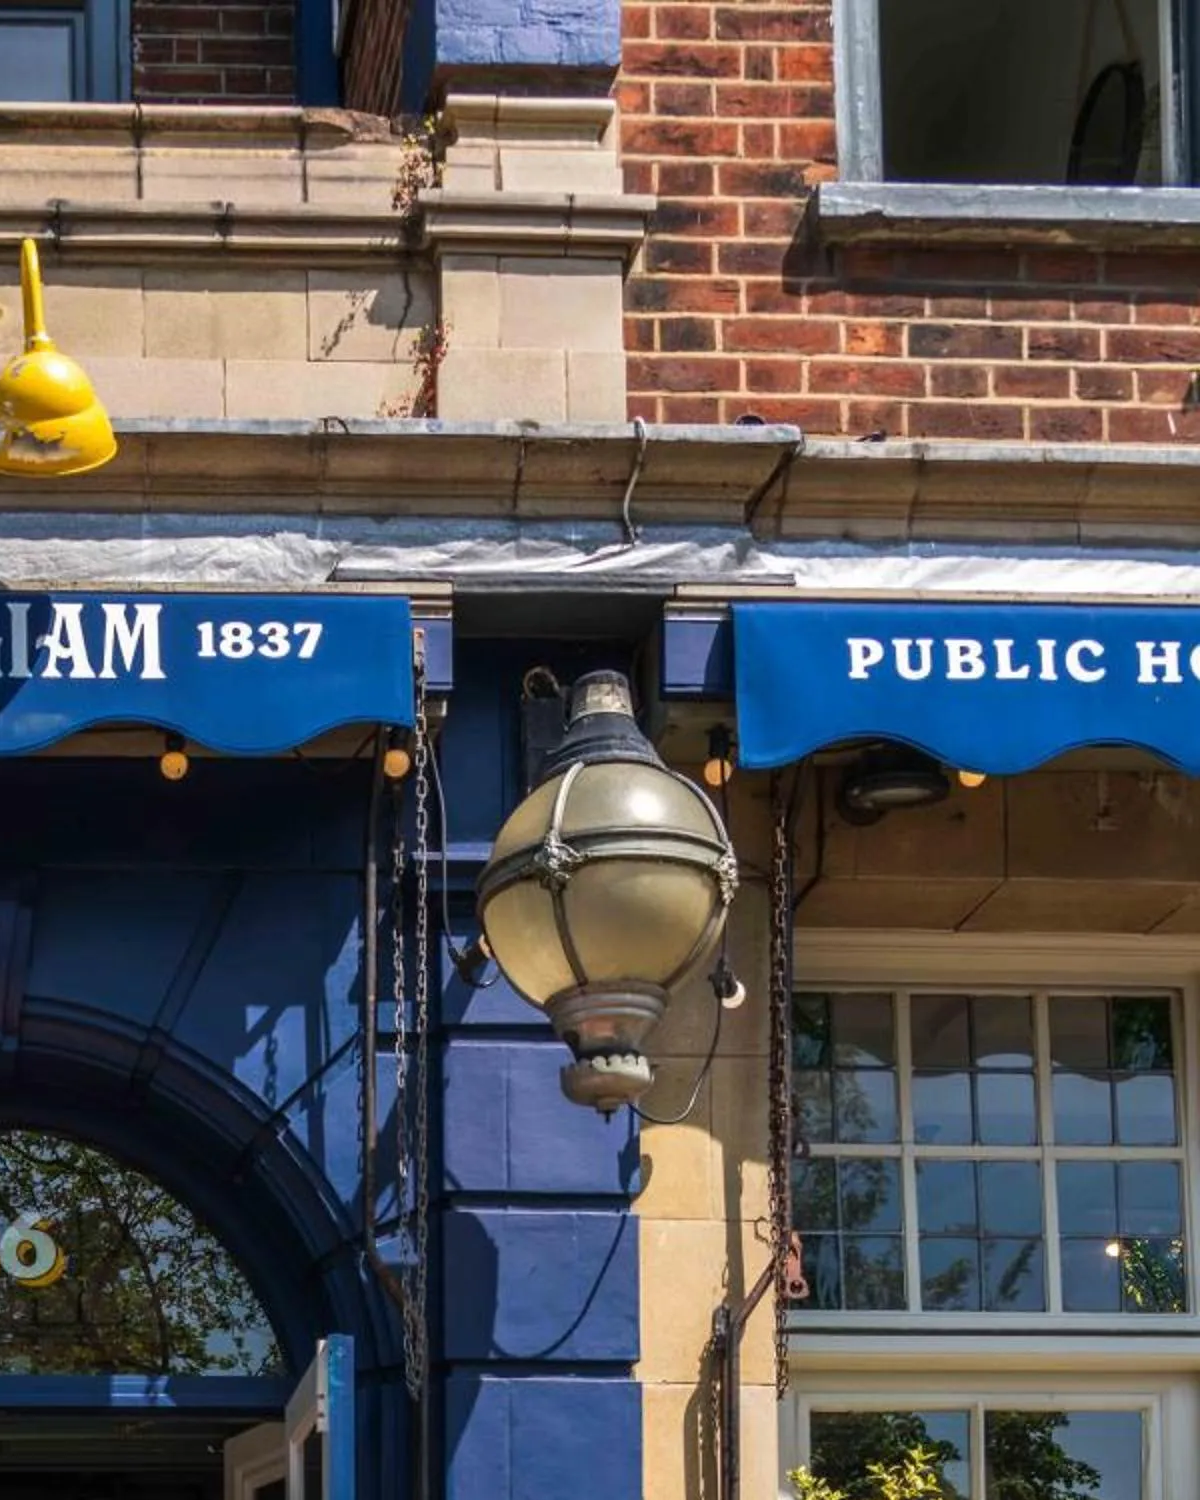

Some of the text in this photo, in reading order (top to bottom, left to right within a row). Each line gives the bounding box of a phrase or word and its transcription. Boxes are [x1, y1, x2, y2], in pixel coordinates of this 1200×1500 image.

[196, 620, 324, 659] 1837
[846, 637, 1200, 684] PUBLIC H
